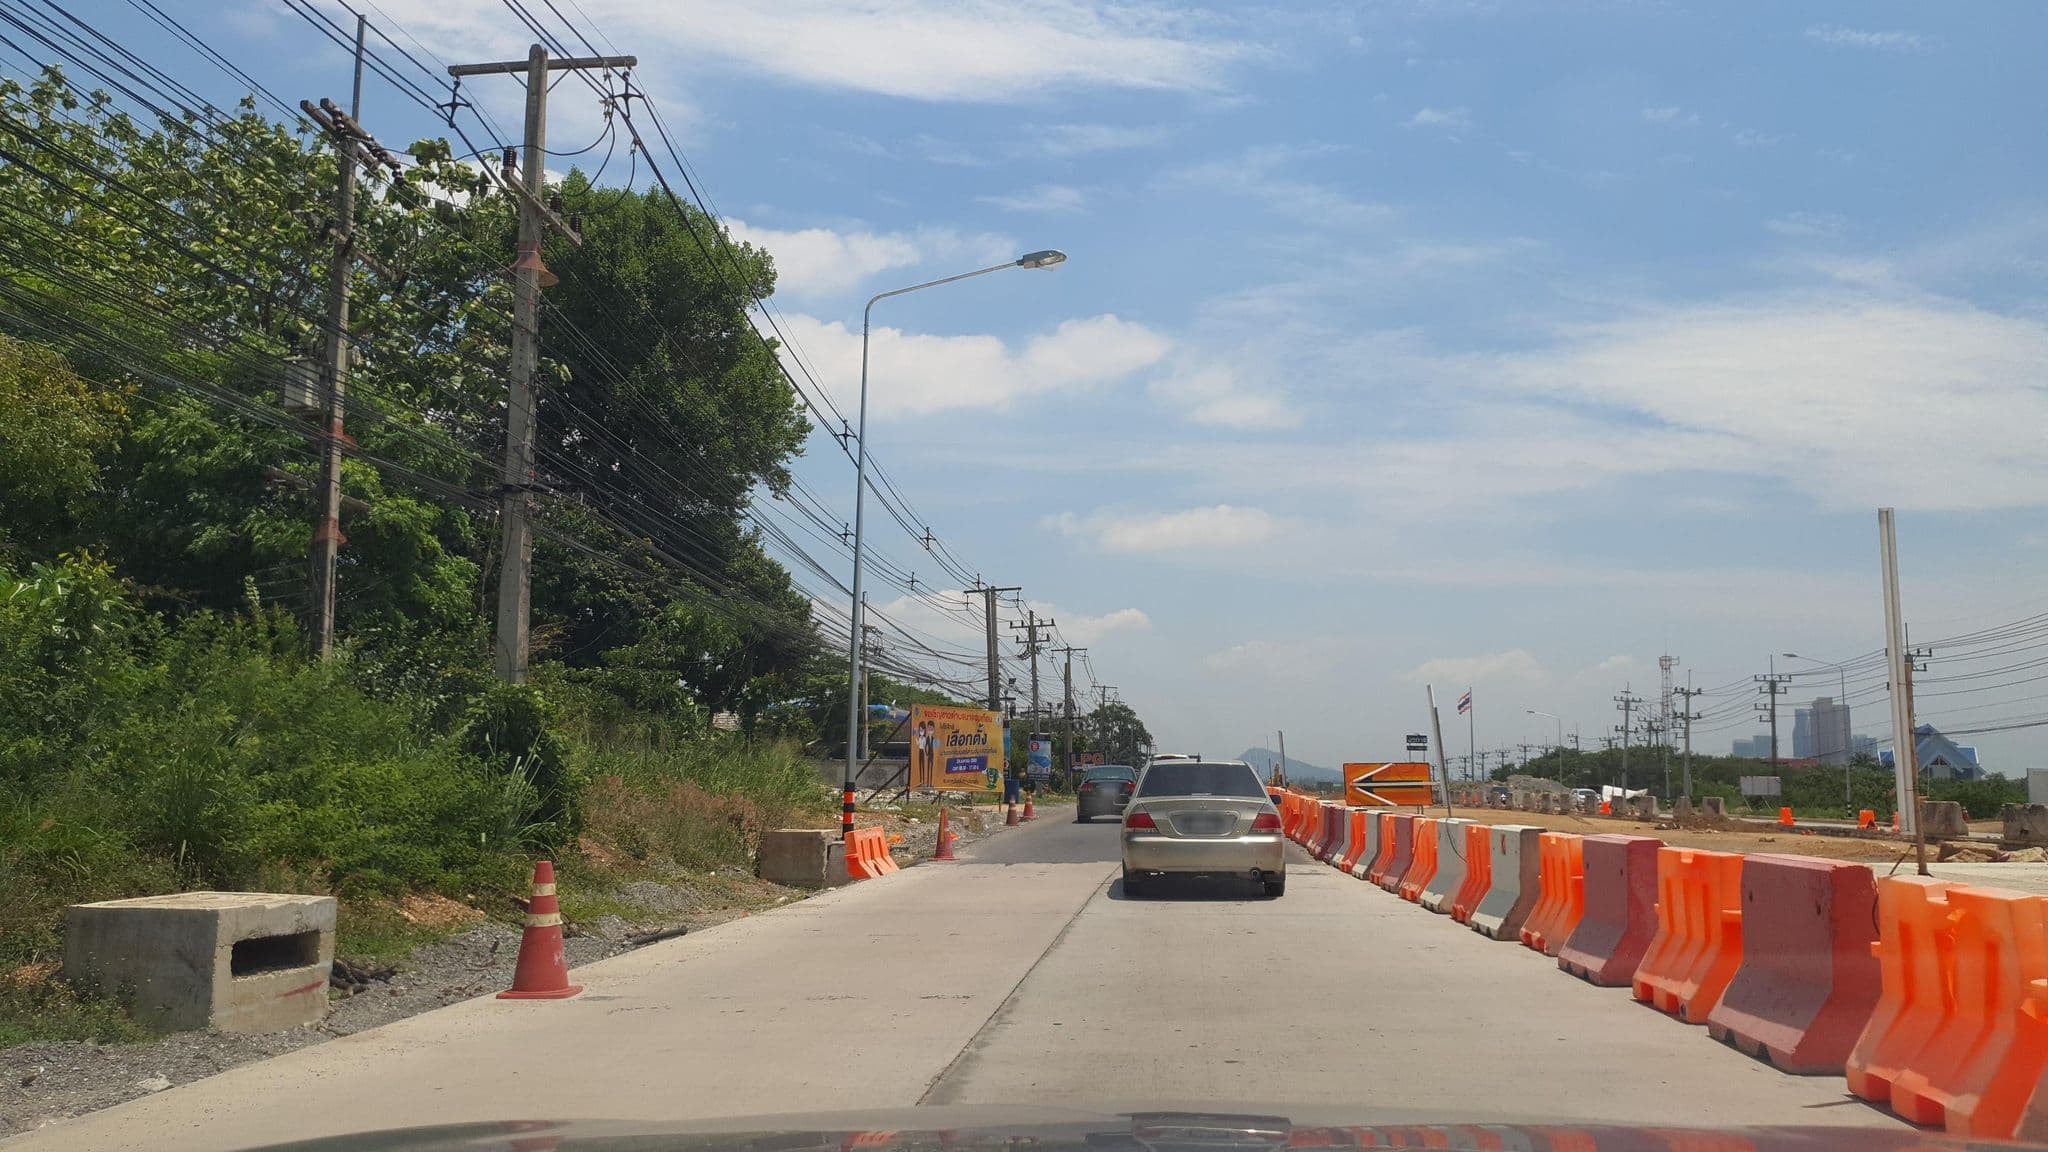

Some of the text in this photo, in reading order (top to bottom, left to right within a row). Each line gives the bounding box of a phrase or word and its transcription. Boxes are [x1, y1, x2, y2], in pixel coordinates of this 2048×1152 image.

[946, 723, 987, 747] เลือกตั้ง
[1071, 752, 1104, 766] LPG
